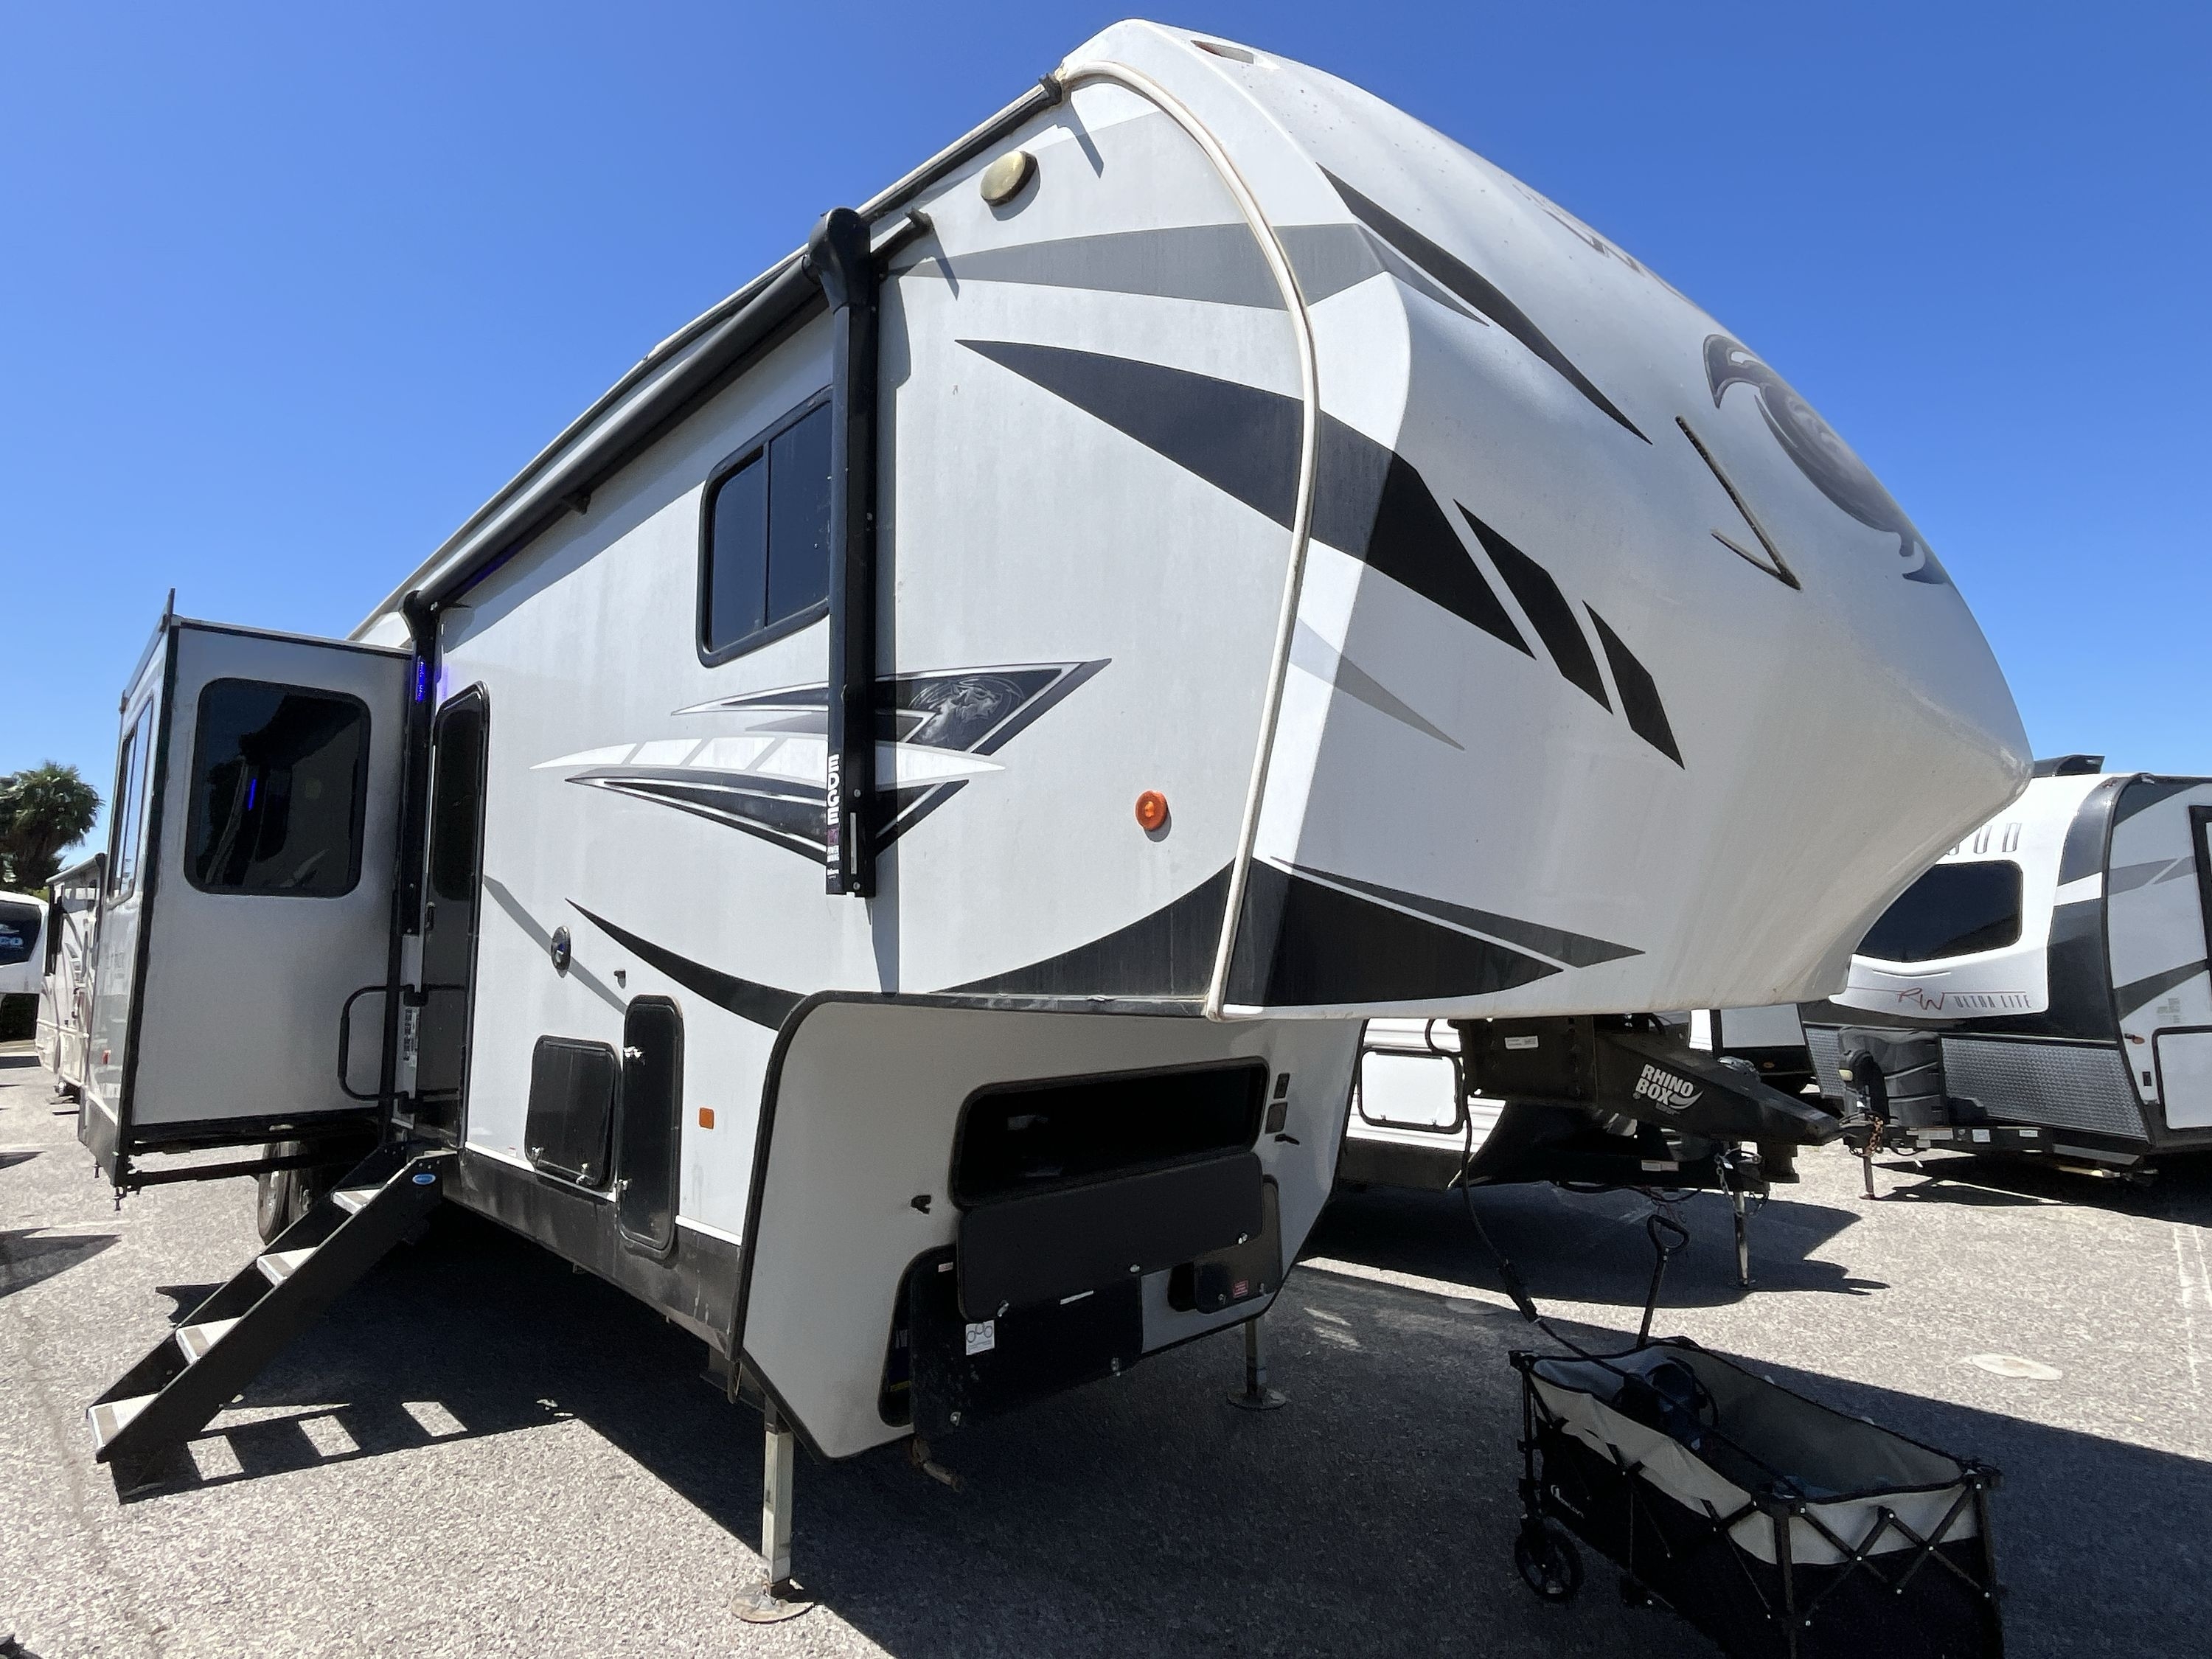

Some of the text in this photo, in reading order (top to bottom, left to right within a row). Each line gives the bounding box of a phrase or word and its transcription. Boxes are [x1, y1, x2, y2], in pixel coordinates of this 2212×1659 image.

[827, 754, 840, 824] EDGE
[1953, 995, 1996, 1009] ULTRA
[2000, 994, 2032, 1009] LITE
[1635, 1077, 1674, 1106] BOX
[1641, 1063, 1694, 1097] RHINO
